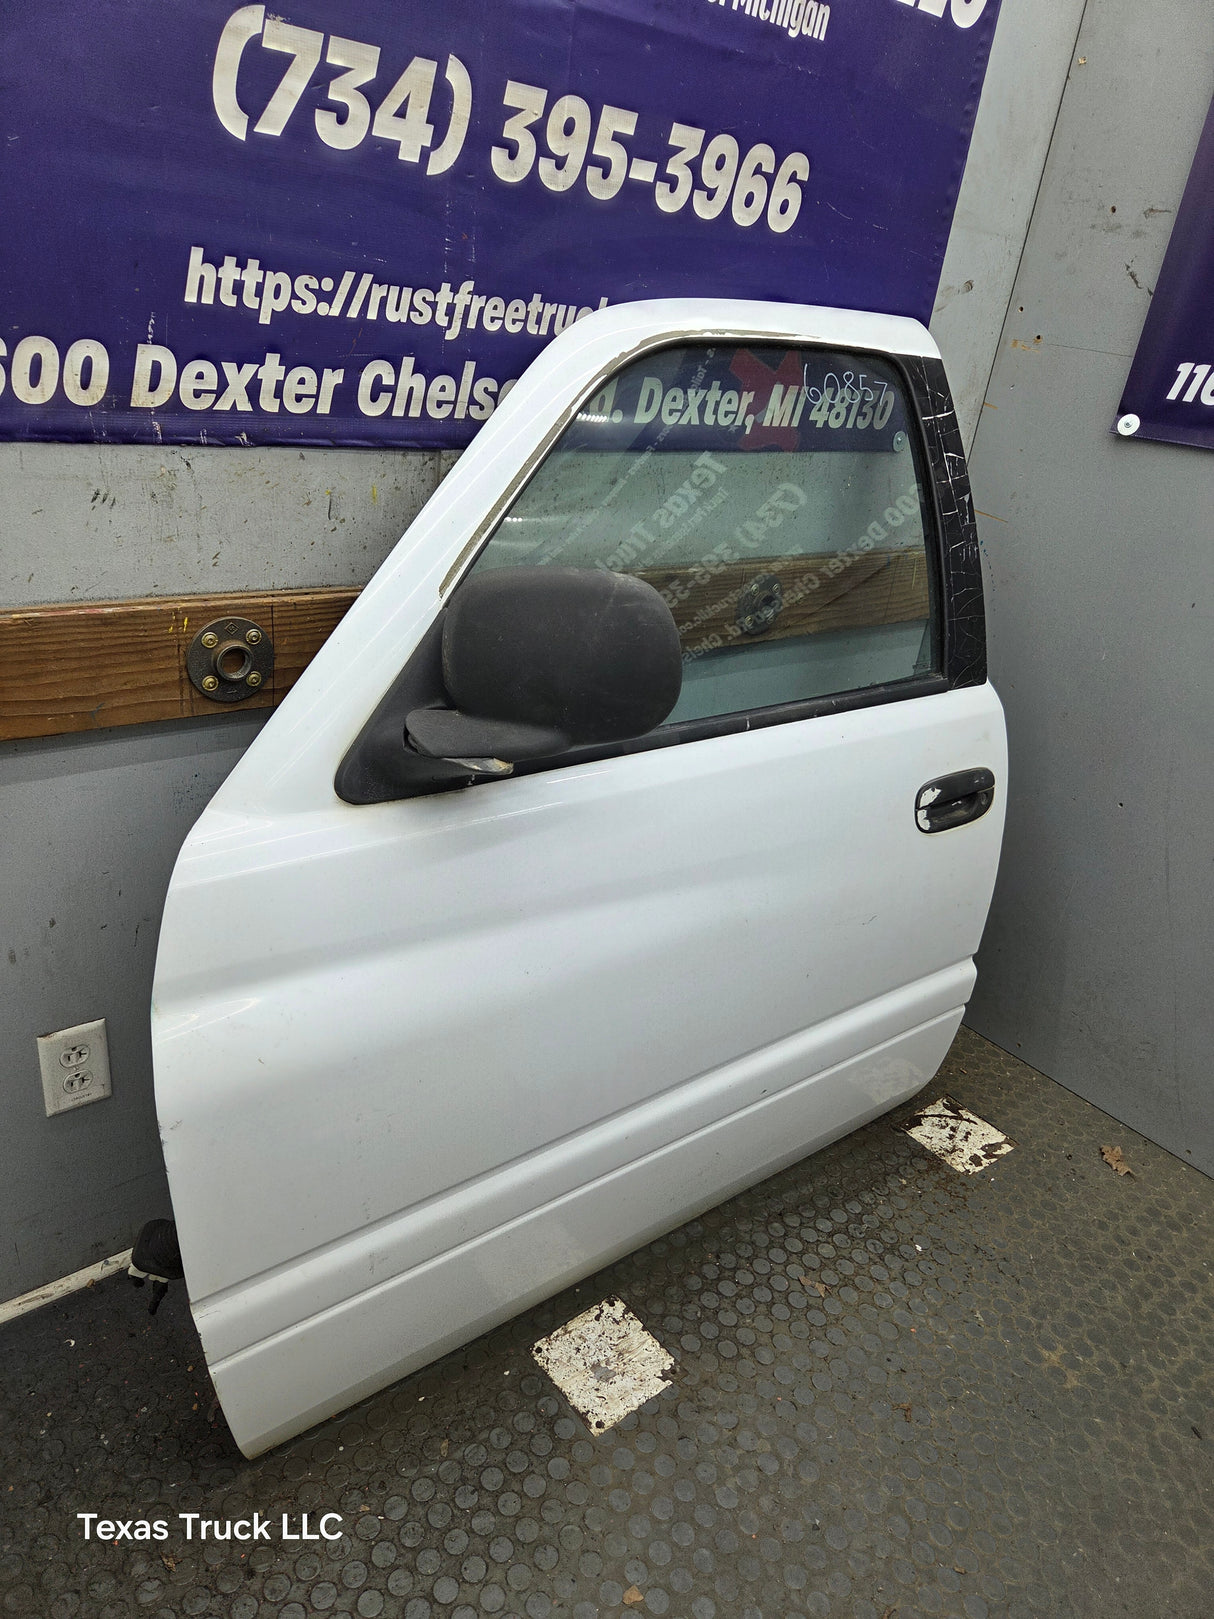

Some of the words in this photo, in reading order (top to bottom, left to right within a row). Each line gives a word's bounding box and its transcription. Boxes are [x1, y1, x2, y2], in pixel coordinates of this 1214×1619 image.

[212, 4, 473, 176] (734)
[490, 80, 810, 234] 395-3966
[183, 246, 609, 341] https://rustfreetru
[0, 335, 110, 407] 00
[130, 343, 345, 415] Dexter
[357, 356, 519, 421] Chels
[634, 376, 756, 435] Dexter,
[762, 384, 809, 428] MI
[808, 387, 895, 430] 48130
[803, 363, 888, 405] 60857
